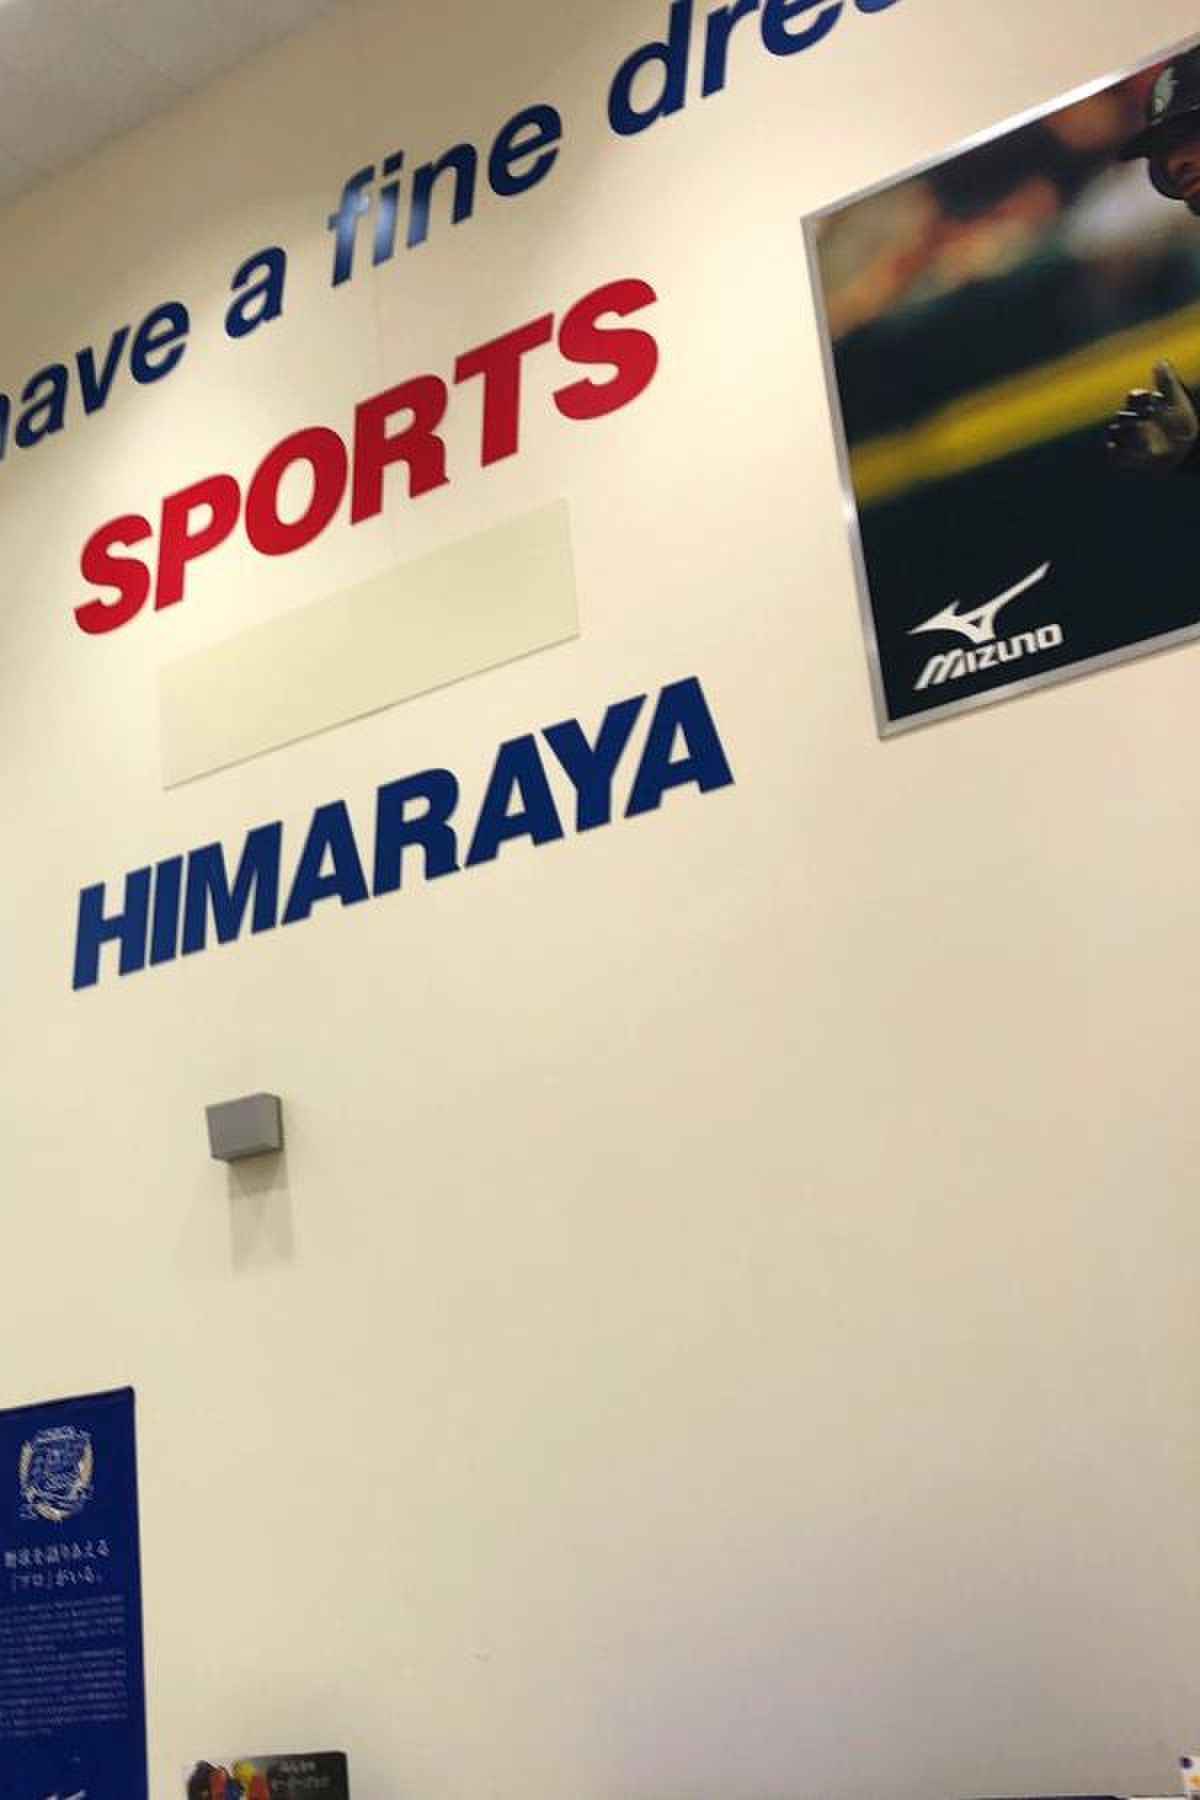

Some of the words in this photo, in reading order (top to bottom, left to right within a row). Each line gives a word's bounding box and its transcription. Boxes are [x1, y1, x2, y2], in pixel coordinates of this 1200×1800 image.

[224, 246, 287, 339] a
[327, 103, 563, 288] fine
[607, 0, 897, 136] dre
[74, 278, 659, 635] SPORTS
[72, 676, 735, 992] HIMARAYA
